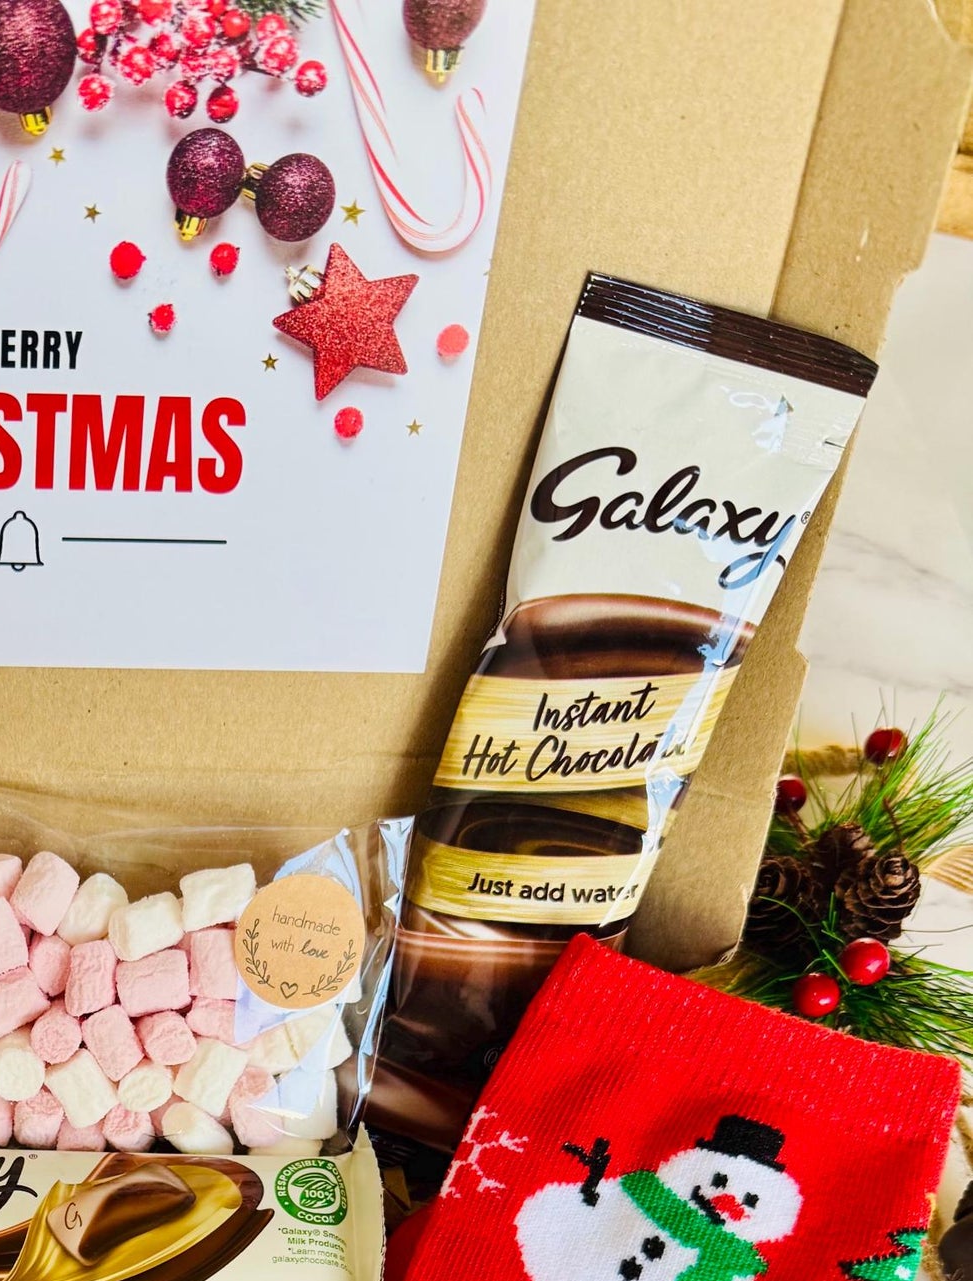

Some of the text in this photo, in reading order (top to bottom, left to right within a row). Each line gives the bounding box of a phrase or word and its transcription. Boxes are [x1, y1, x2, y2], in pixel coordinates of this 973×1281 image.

[530, 446, 798, 590] Galaxy
[533, 682, 659, 732] Instant
[462, 734, 519, 779] Hot
[467, 873, 514, 897] Just
[519, 881, 565, 902] add
[272, 905, 342, 936] handmade
[271, 935, 329, 959] with love
[277, 1160, 326, 1197] RESPONSIBLY
[304, 1190, 335, 1202] 100%
[287, 1237, 306, 1245] Milk
